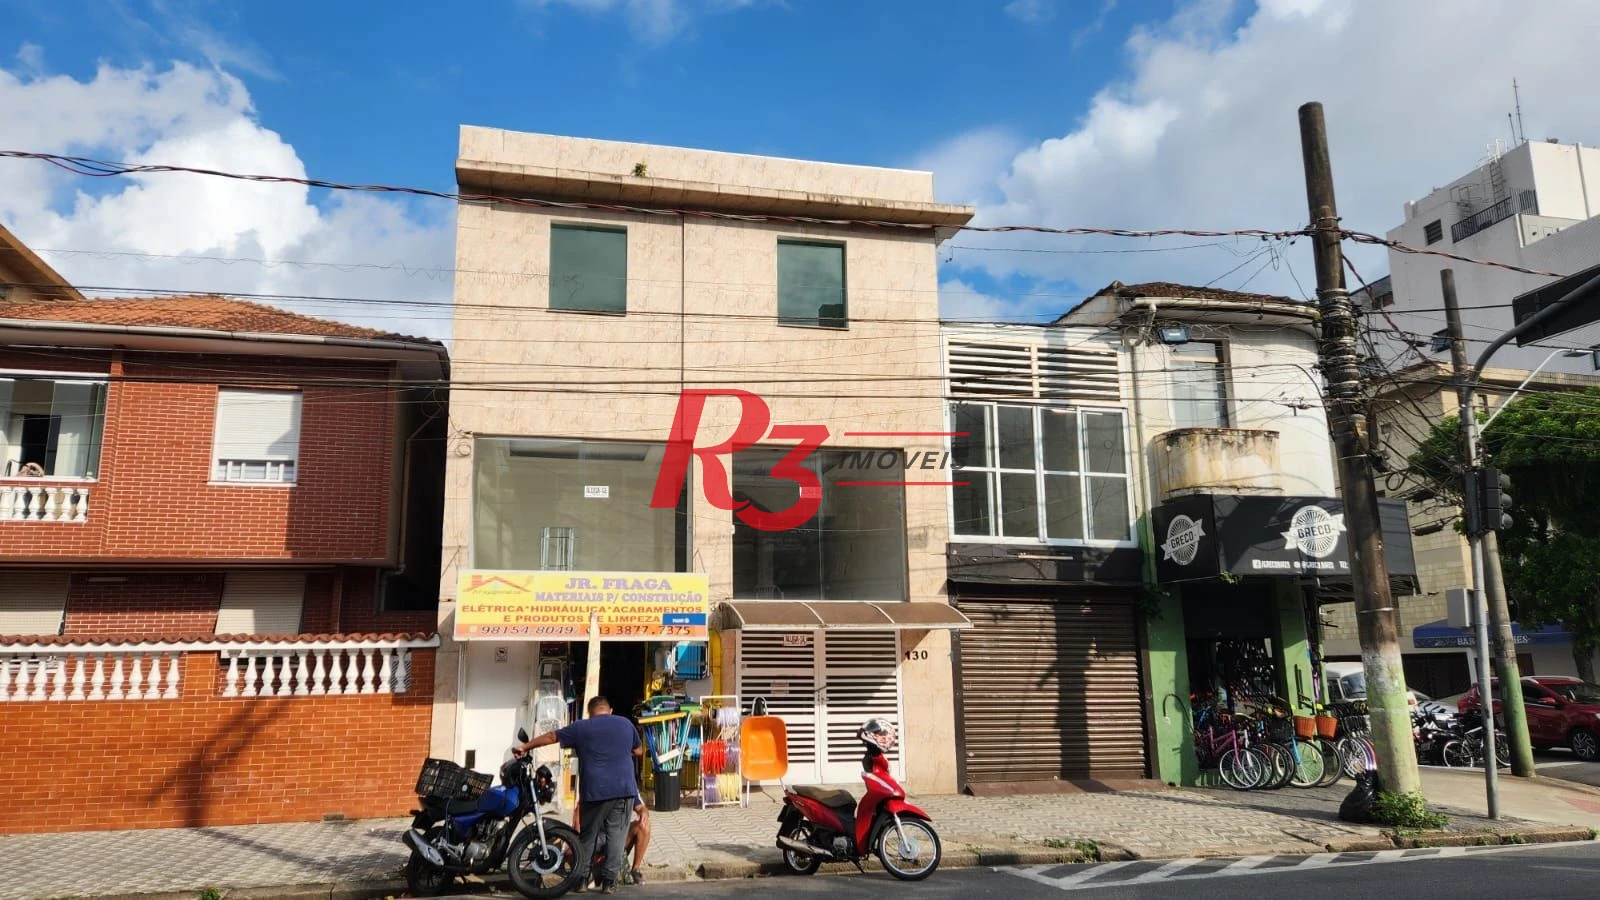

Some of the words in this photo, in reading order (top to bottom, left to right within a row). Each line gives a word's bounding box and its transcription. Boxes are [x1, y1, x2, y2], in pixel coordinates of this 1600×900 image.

[1297, 523, 1332, 539] GRECO
[1170, 530, 1194, 549] GRECO
[565, 577, 598, 589] JR.
[603, 578, 672, 590] FRAGA
[535, 591, 604, 602] MATERIAIS
[607, 593, 619, 604] P/
[622, 590, 703, 605] CONSTRUÇÃO
[608, 615, 661, 623] LIMPEZA
[481, 625, 529, 635] 98154
[535, 626, 574, 635] 8049
[616, 625, 691, 635] 3877.7375
[905, 650, 928, 661] 130
